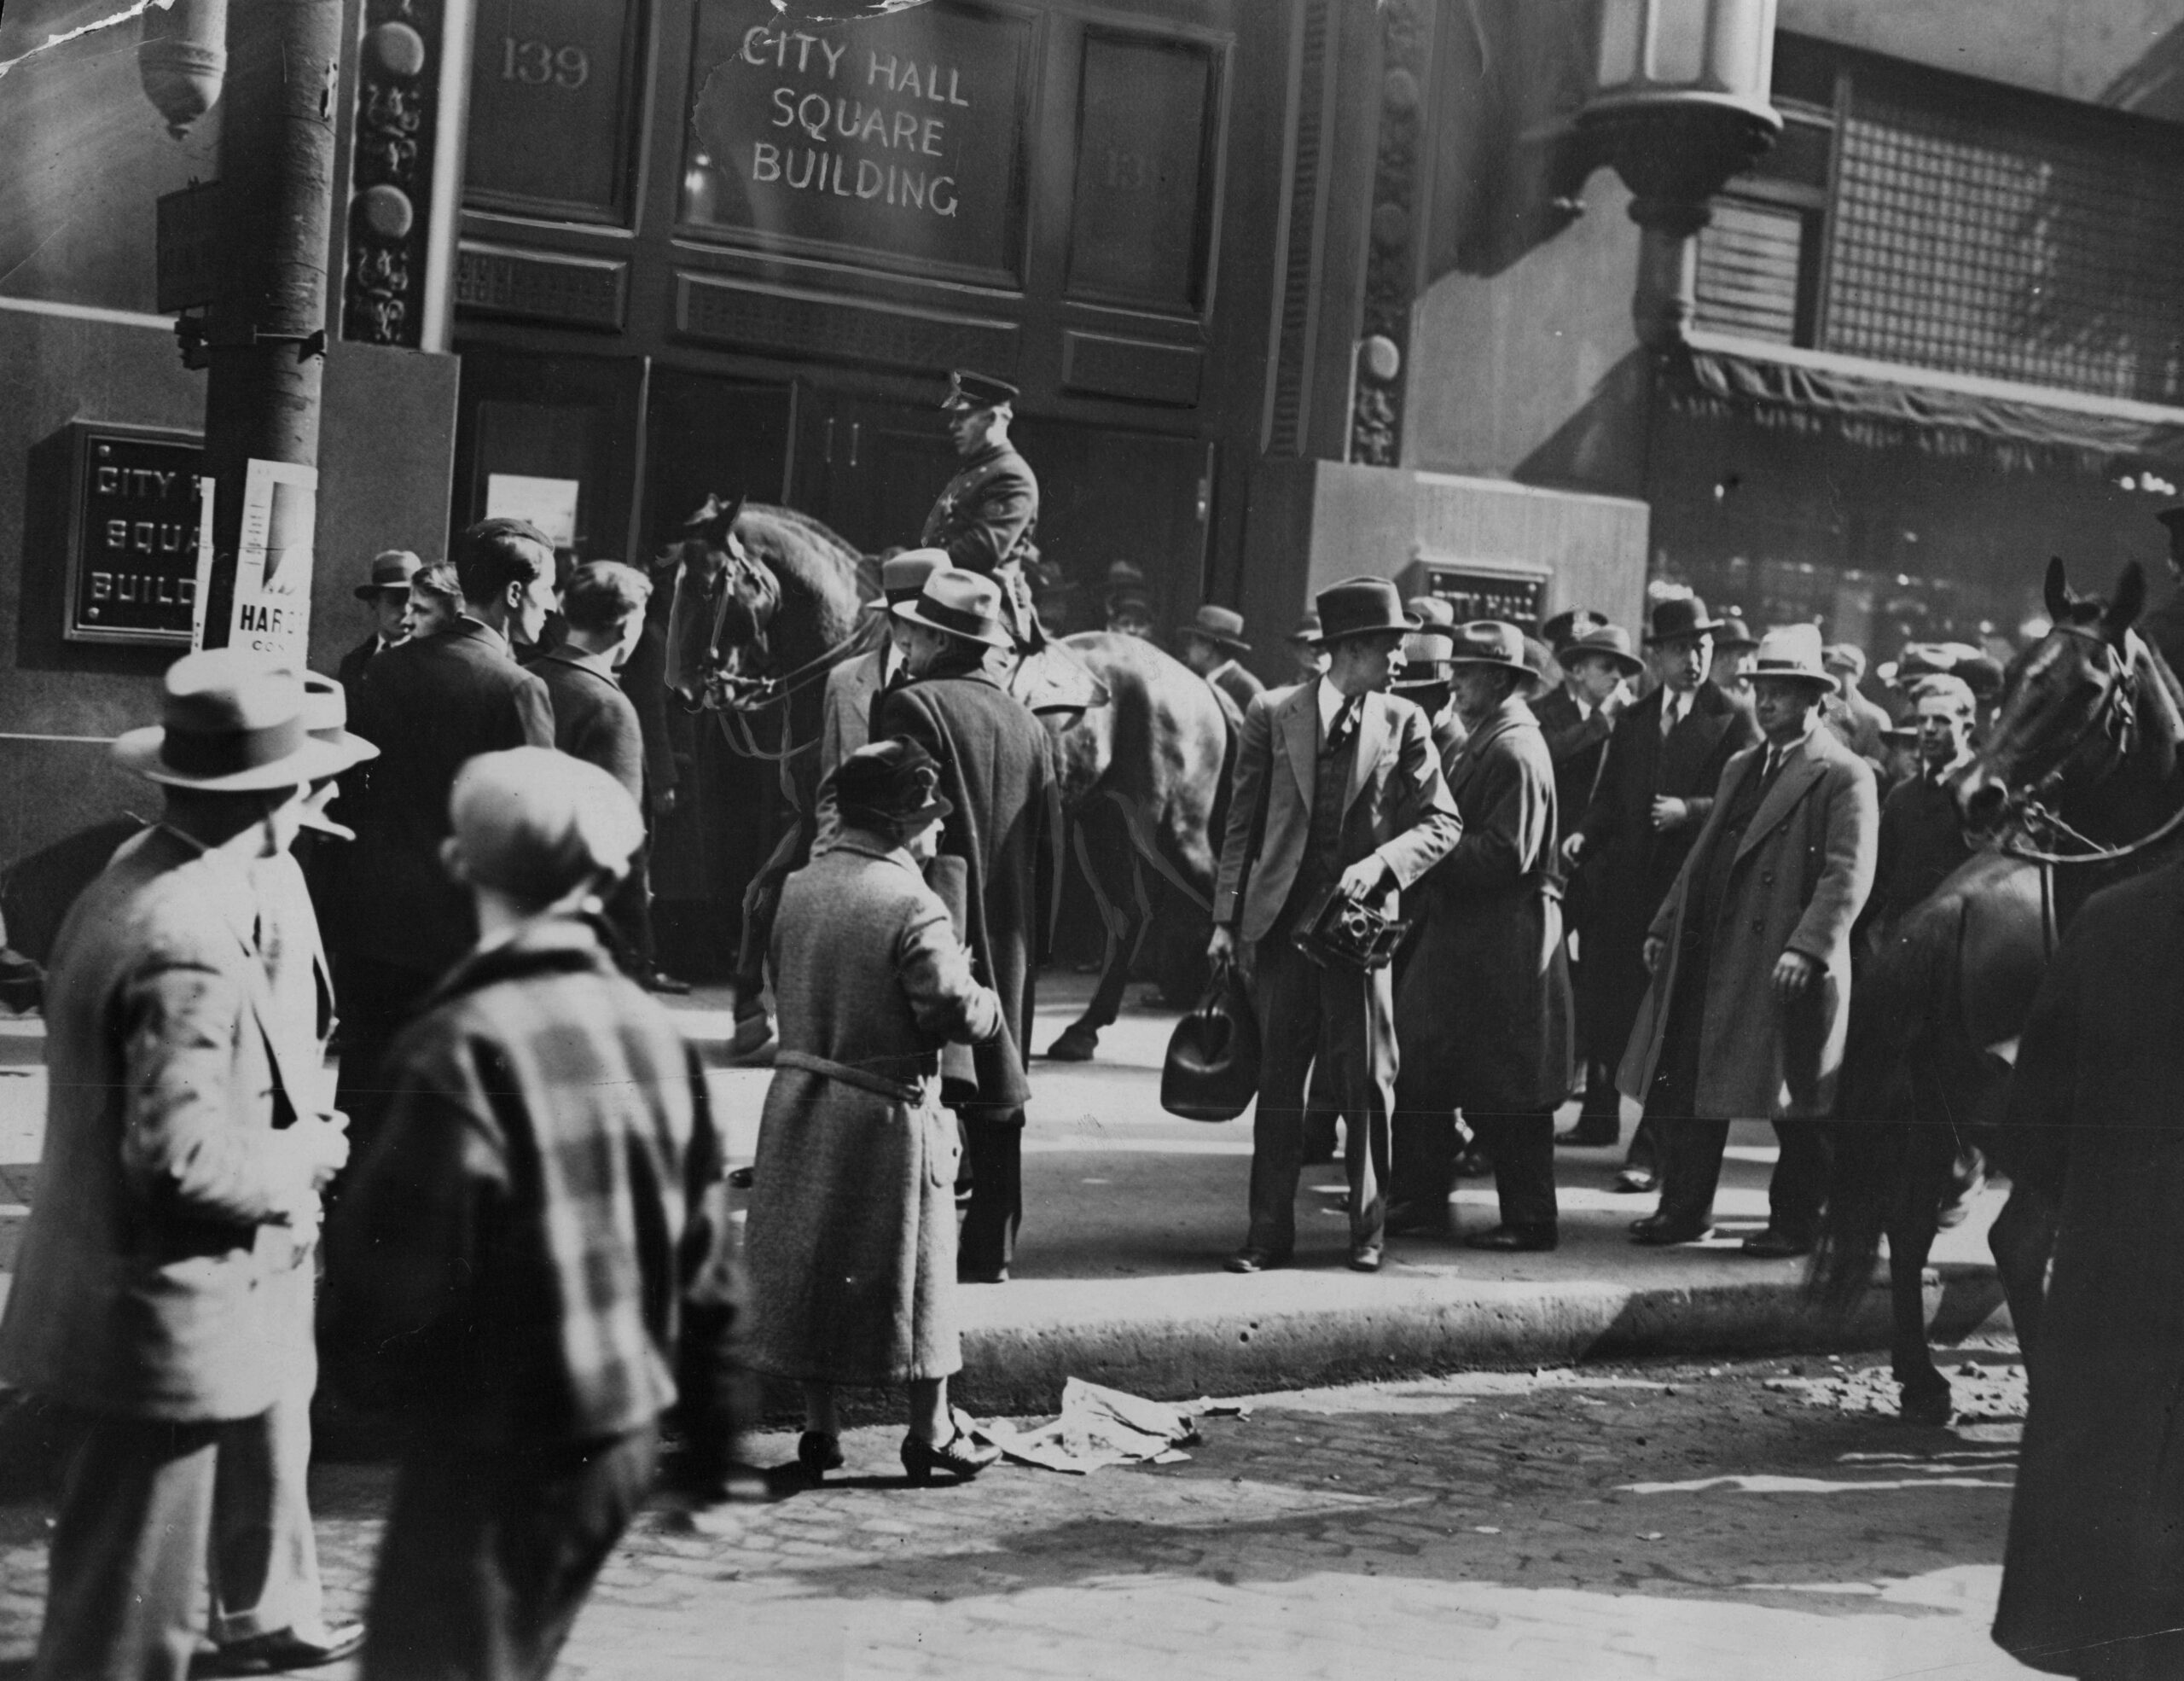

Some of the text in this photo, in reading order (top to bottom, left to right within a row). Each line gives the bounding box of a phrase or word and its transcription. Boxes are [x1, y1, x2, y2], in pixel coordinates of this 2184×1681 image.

[502, 38, 588, 89] 139
[743, 26, 969, 107] CITY HALL
[772, 88, 944, 156] SQUARE
[752, 142, 958, 218] BUILDING
[98, 467, 176, 497] CITY
[91, 572, 197, 604] BUILD
[240, 603, 294, 634] HAR
